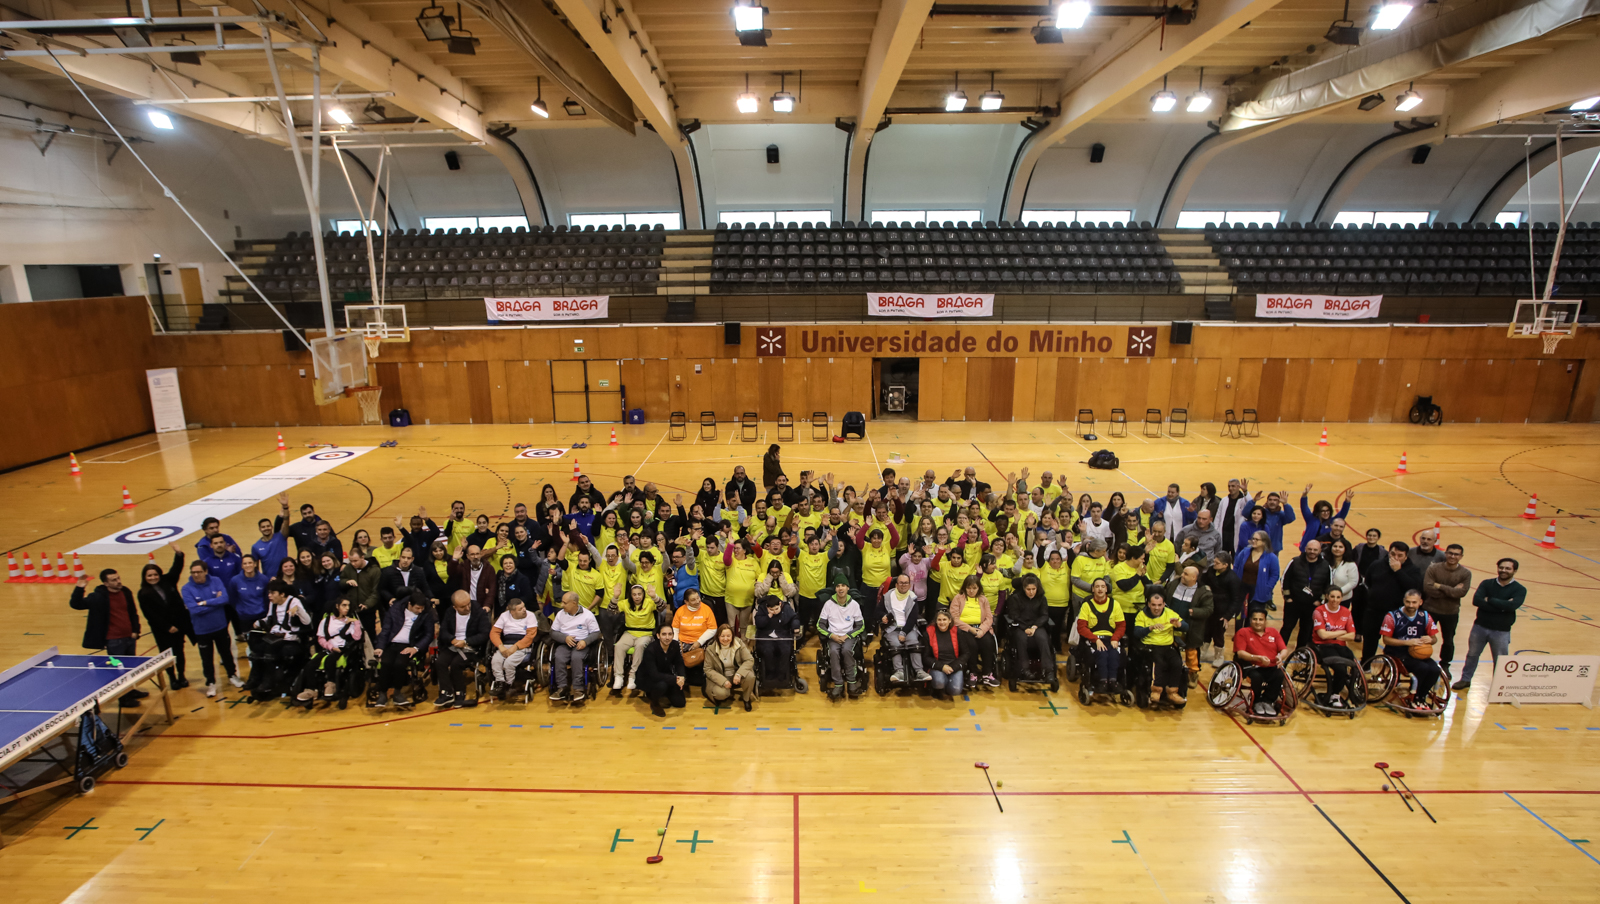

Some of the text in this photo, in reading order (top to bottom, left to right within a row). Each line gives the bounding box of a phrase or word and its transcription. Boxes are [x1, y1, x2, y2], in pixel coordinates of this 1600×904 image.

[496, 299, 598, 312] BRAGA BRAGA
[878, 295, 983, 308] BRAGA BRAGA
[1267, 297, 1371, 311] BRAGA BRAGA
[802, 330, 1113, 353] Universidade do Minho
[1406, 626, 1417, 635] 85
[1522, 663, 1574, 673] Cachapuz
[25, 706, 78, 742] WWW.BOCCIA.PT
[130, 650, 171, 678] WWW.BOCCIA.PT
